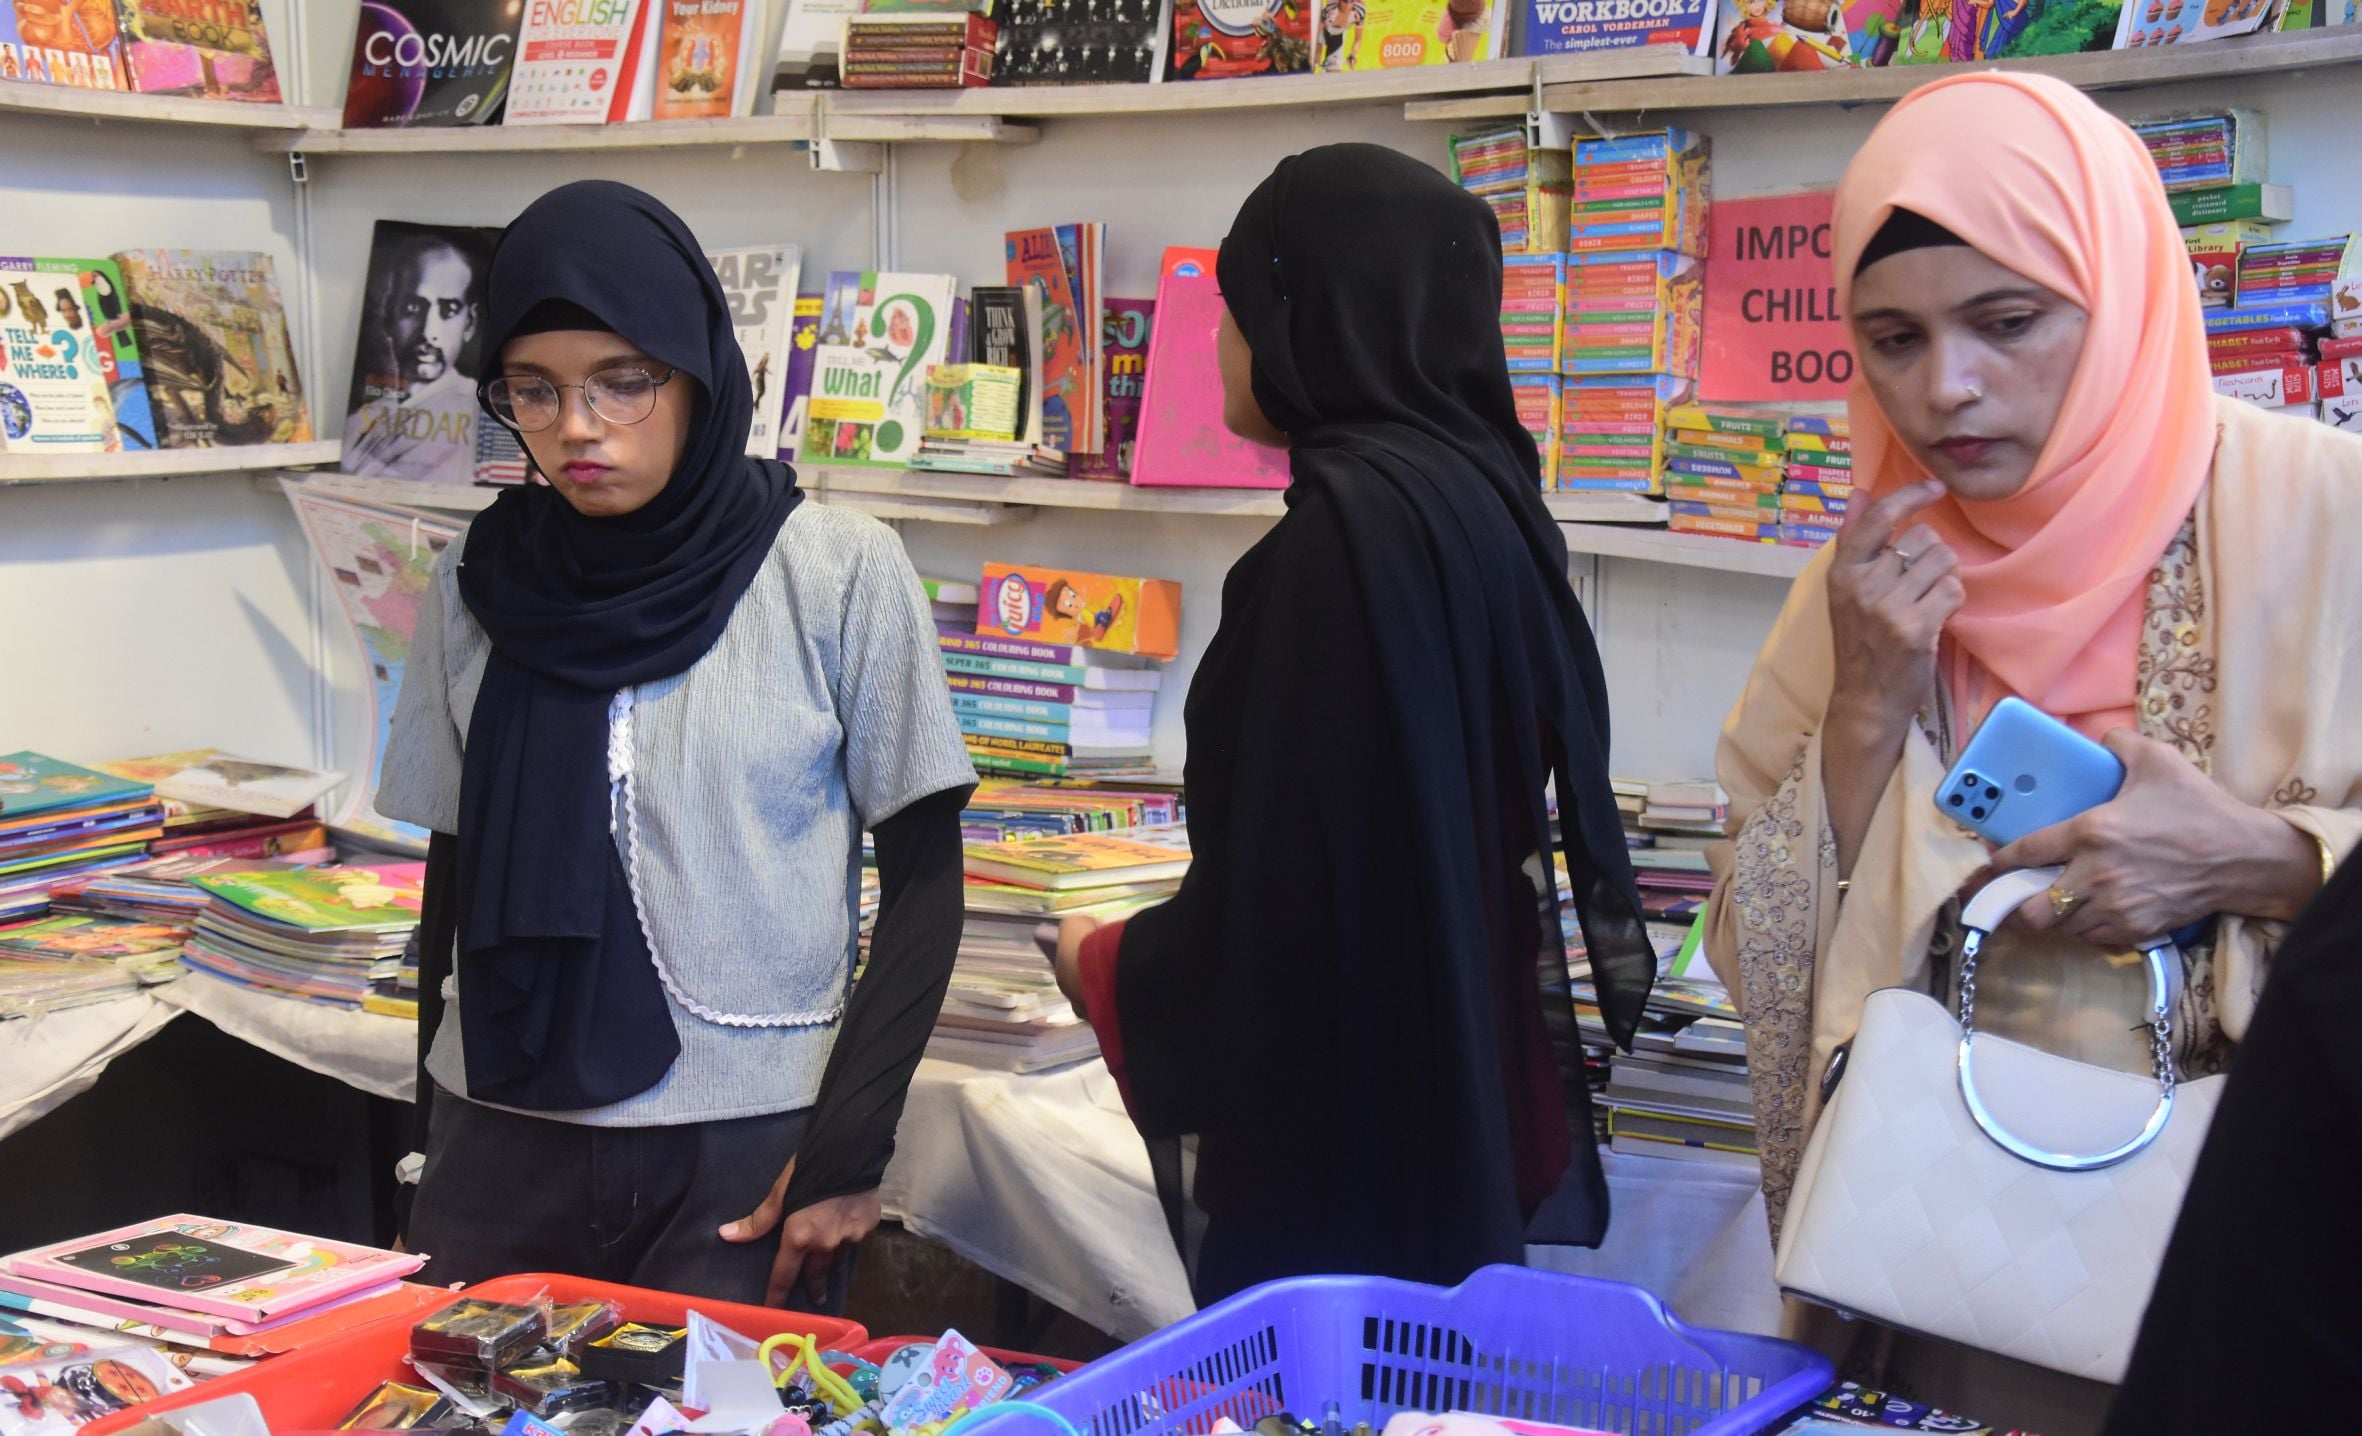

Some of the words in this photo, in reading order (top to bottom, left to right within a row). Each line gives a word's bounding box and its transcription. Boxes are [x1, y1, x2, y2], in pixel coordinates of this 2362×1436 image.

[530, 0, 630, 27] ENGLISH
[672, 0, 699, 16] Your
[701, 0, 739, 16] Kidney
[1536, 0, 1684, 24] WORKBOOK
[1688, 0, 1700, 13] 2
[172, 20, 234, 49] BOOK
[1561, 25, 1597, 35] CAROL
[1603, 18, 1670, 32] VORDERMAN
[365, 31, 511, 67] COSMIC
[1383, 42, 1421, 58] 8000
[1544, 39, 1563, 49] The
[1565, 36, 1638, 49] simplest-ever
[2192, 200, 2227, 209] crossword
[2197, 194, 2221, 203] pocket
[2192, 207, 2227, 217] dictionary
[2188, 244, 2224, 254] Library
[36, 262, 79, 273] FLEMING
[148, 266, 204, 281] HARRY
[209, 268, 266, 283] POTTER
[985, 307, 1016, 329] THINK
[5, 328, 39, 344] TELL
[991, 329, 1016, 347] GROW
[11, 346, 34, 361] ME
[13, 364, 67, 380] WHERE
[1770, 350, 1854, 384] BOO
[824, 367, 882, 398] What
[357, 402, 471, 446] SARDAR
[1720, 421, 1751, 431] FRUITS
[1707, 434, 1744, 444] ANIMALS
[1693, 450, 1726, 461] FRUITS
[1691, 463, 1732, 475] NUMBERS
[1818, 476, 1850, 484] COLOURS
[1698, 490, 1736, 501] ANIMALS
[965, 638, 980, 650] 365
[982, 641, 1029, 656] COLOURING
[1031, 647, 1056, 659] BOOK
[946, 656, 972, 667] SUPER
[975, 660, 990, 670] 365
[992, 663, 1039, 676] COLOURING
[1041, 668, 1064, 679] BOOK
[969, 679, 986, 690] 365
[987, 681, 1034, 695] COLOURING
[1035, 686, 1059, 698] BOOK
[962, 699, 977, 709] 365
[979, 701, 1024, 714] COLOURING
[1026, 705, 1048, 716] BOOK
[979, 720, 1024, 733] COLOURING
[1026, 725, 1048, 736] BOOK
[990, 738, 1017, 750] NOBEL
[1019, 741, 1065, 755] LAUREATES
